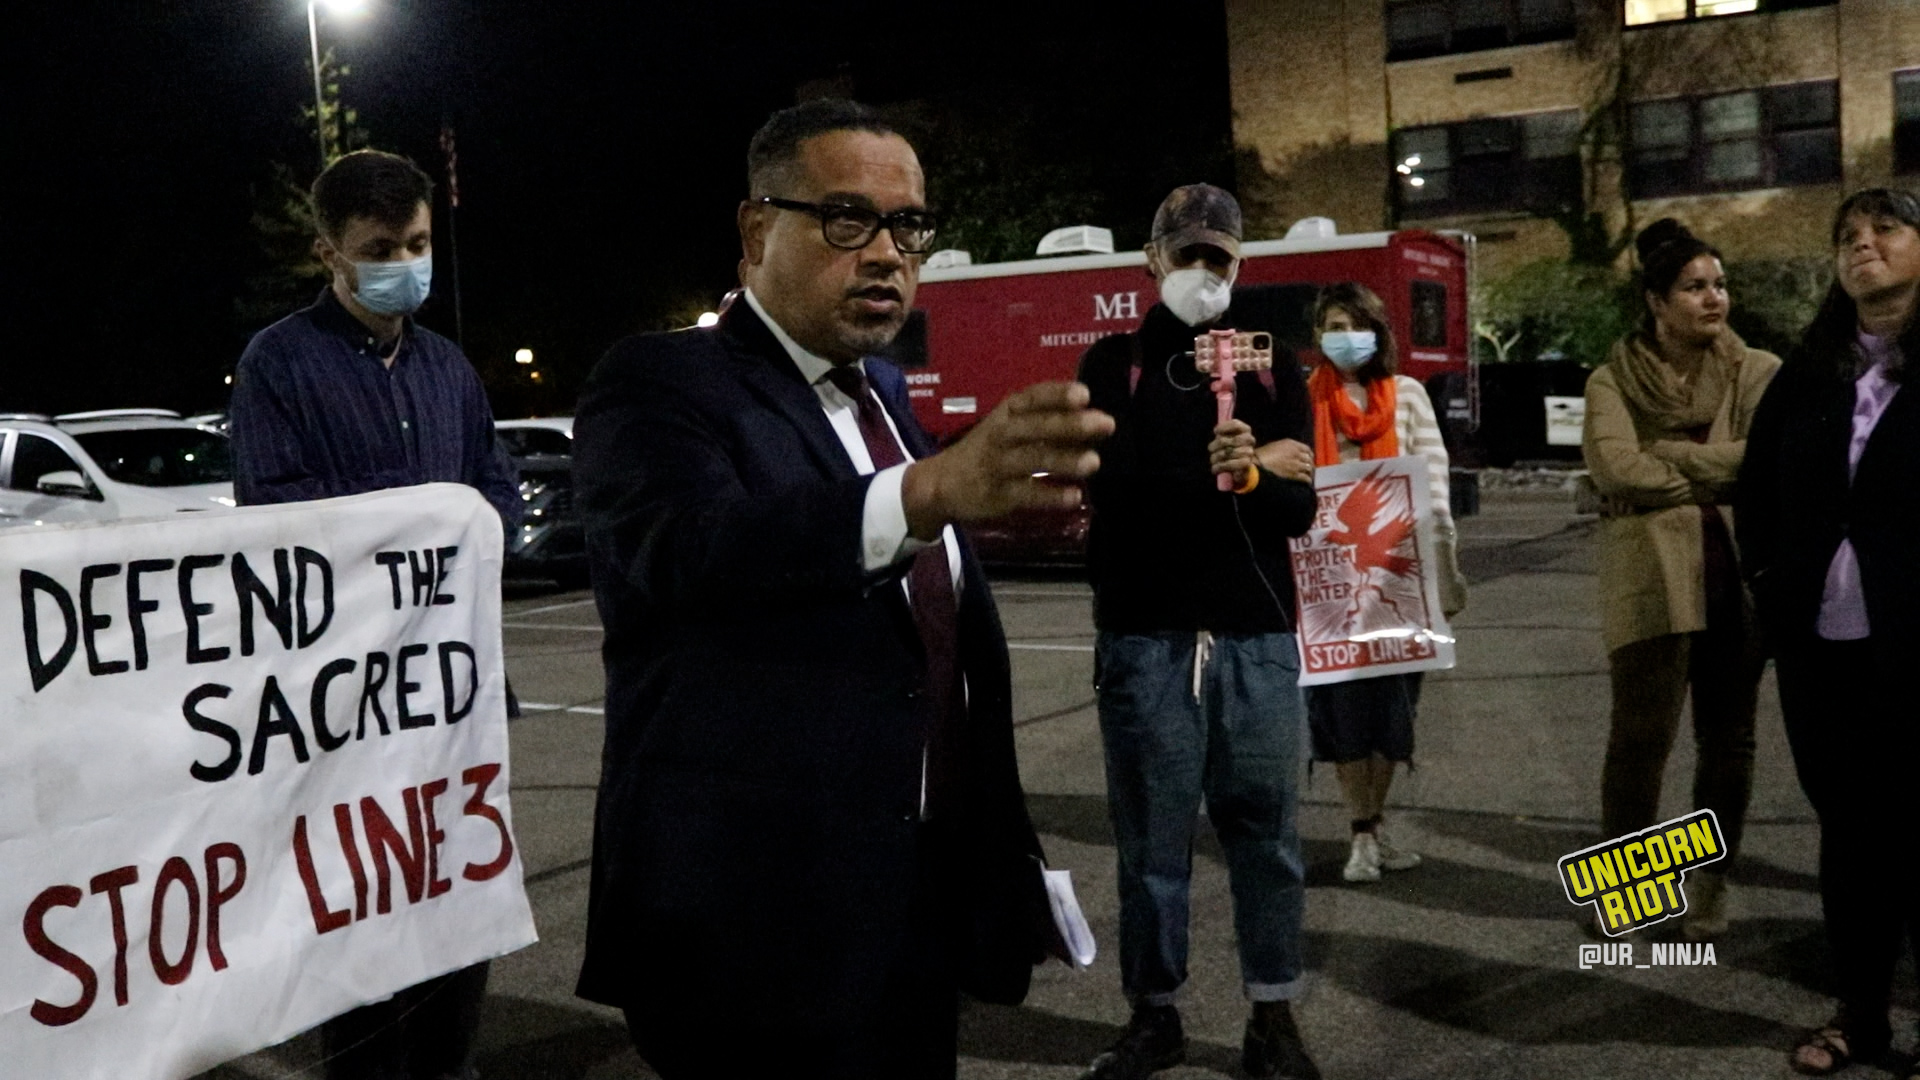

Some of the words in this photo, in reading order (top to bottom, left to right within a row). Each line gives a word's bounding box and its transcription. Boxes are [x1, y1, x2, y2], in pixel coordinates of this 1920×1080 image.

[1093, 291, 1139, 320] MH
[1040, 331, 1112, 347] MITCHE
[1293, 544, 1358, 569] PROTECT
[1296, 567, 1328, 588] THE
[1300, 582, 1353, 604] WATER
[20, 546, 335, 693] DEFEND
[376, 546, 458, 609] THE
[1309, 642, 1361, 669] STOP
[1367, 637, 1414, 662] LINE
[182, 641, 478, 783] SACRED
[23, 842, 246, 1026] STOP
[293, 778, 452, 934] LINE
[461, 763, 513, 882] 3
